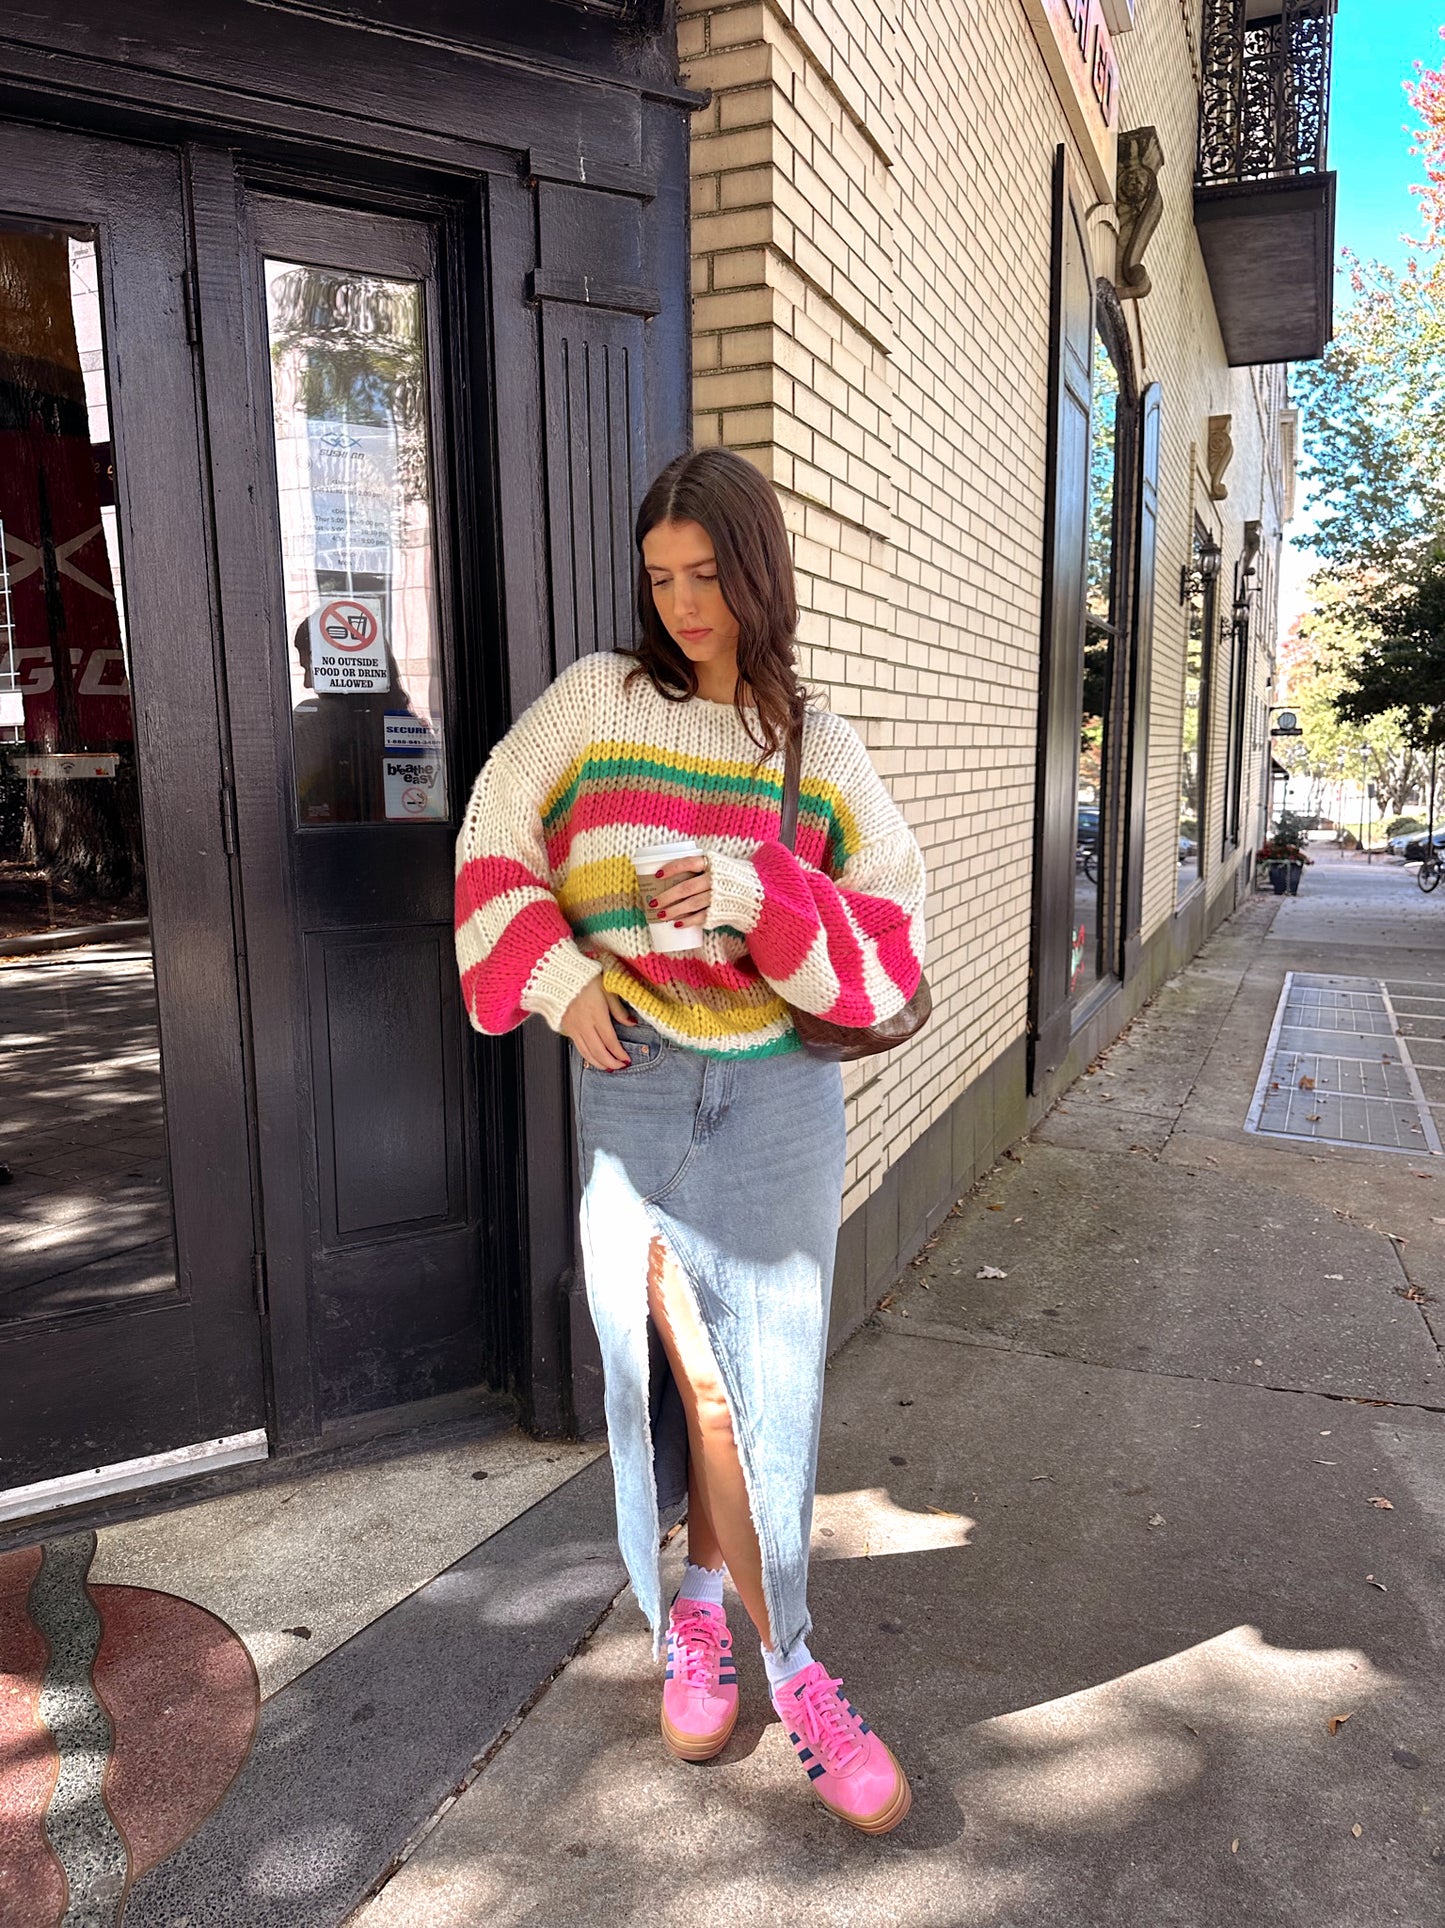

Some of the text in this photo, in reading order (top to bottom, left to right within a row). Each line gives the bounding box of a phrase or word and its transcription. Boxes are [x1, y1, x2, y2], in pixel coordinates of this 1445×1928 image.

[319, 449, 348, 458] SUSHI
[322, 657, 379, 667] NO OUTSIDE
[314, 667, 387, 678] FOOD OR DRINK
[330, 679, 373, 688] ALLOWED
[387, 763, 433, 776] breathe
[404, 771, 437, 788] easy
